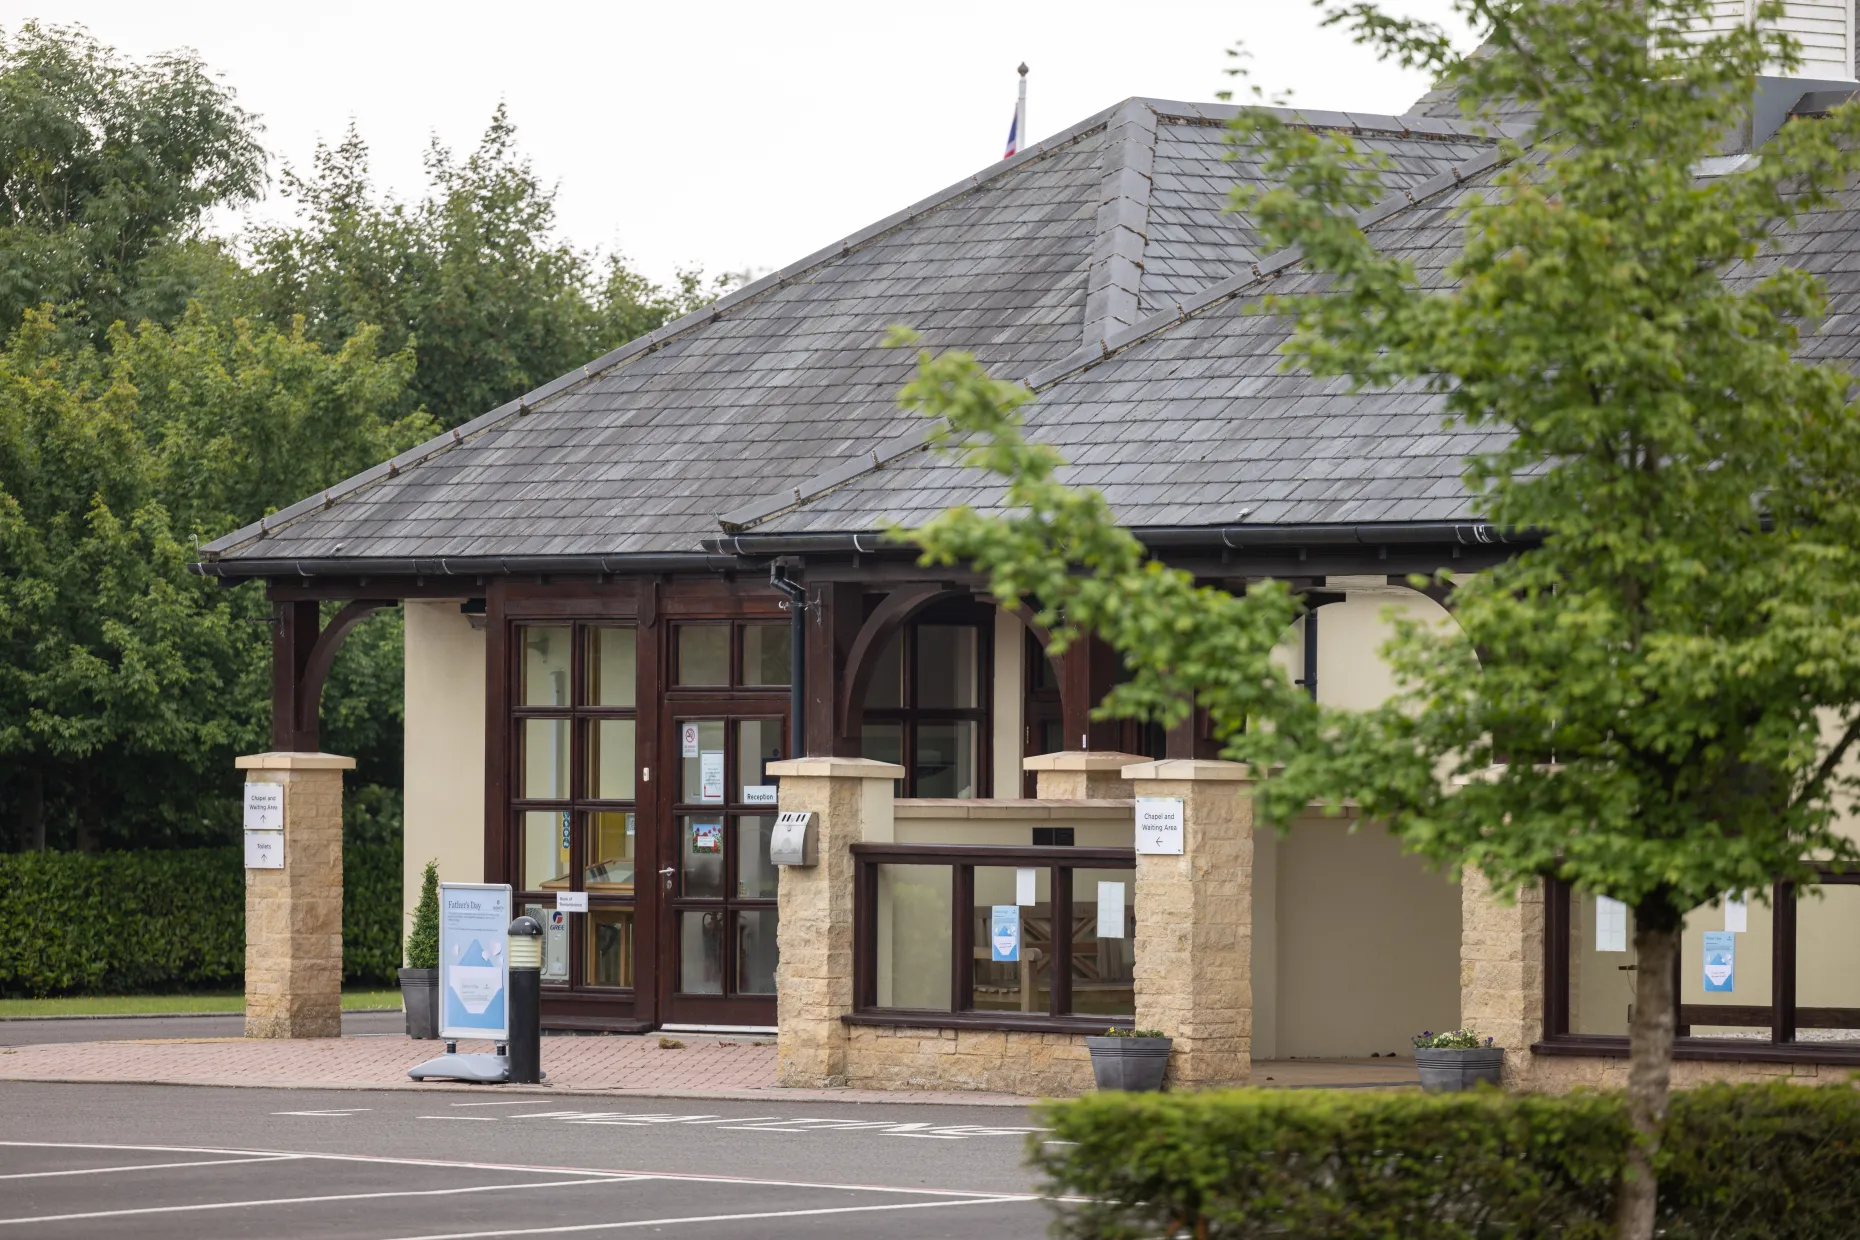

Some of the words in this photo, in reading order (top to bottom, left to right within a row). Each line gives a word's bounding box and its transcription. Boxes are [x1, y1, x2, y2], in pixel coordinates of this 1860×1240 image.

[747, 793, 774, 801] Reception
[1144, 812, 1163, 821] Chapel
[1142, 824, 1163, 832] Waiting
[448, 900, 470, 909] Father's
[470, 901, 481, 911] Day
[508, 1111, 1055, 1136] WAITING
